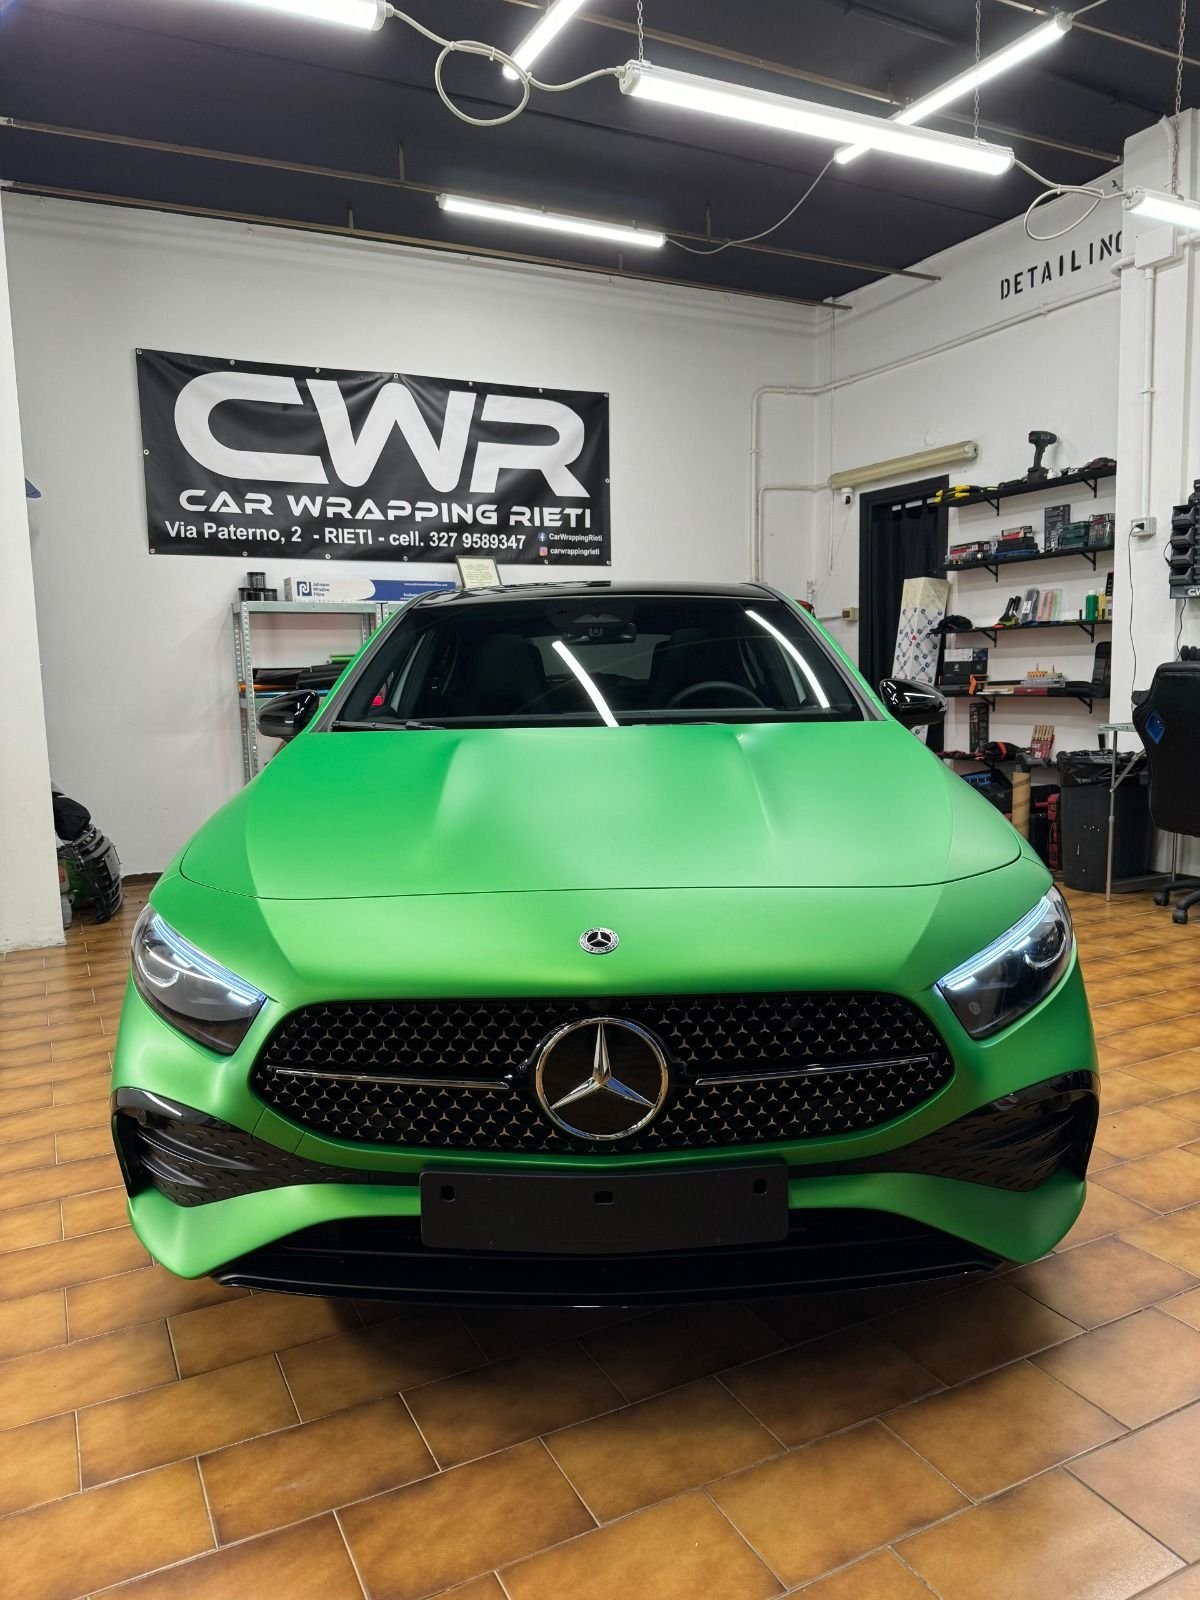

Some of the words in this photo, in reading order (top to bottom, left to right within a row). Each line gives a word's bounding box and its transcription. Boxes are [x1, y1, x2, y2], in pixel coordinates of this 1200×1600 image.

[174, 371, 591, 498] CWR
[179, 489, 274, 515] CAR
[286, 494, 498, 525] WRAPPING
[509, 505, 591, 529] RIETI
[164, 520, 198, 539] Via
[203, 522, 286, 545] Paterno,
[291, 526, 302, 542] 2
[324, 527, 373, 545] RIETI
[389, 530, 425, 547] cell.
[429, 531, 458, 548] 327
[462, 532, 527, 550] 9589347
[548, 533, 603, 543] CarWrappingRieti
[550, 547, 600, 557] carwrappingrieti
